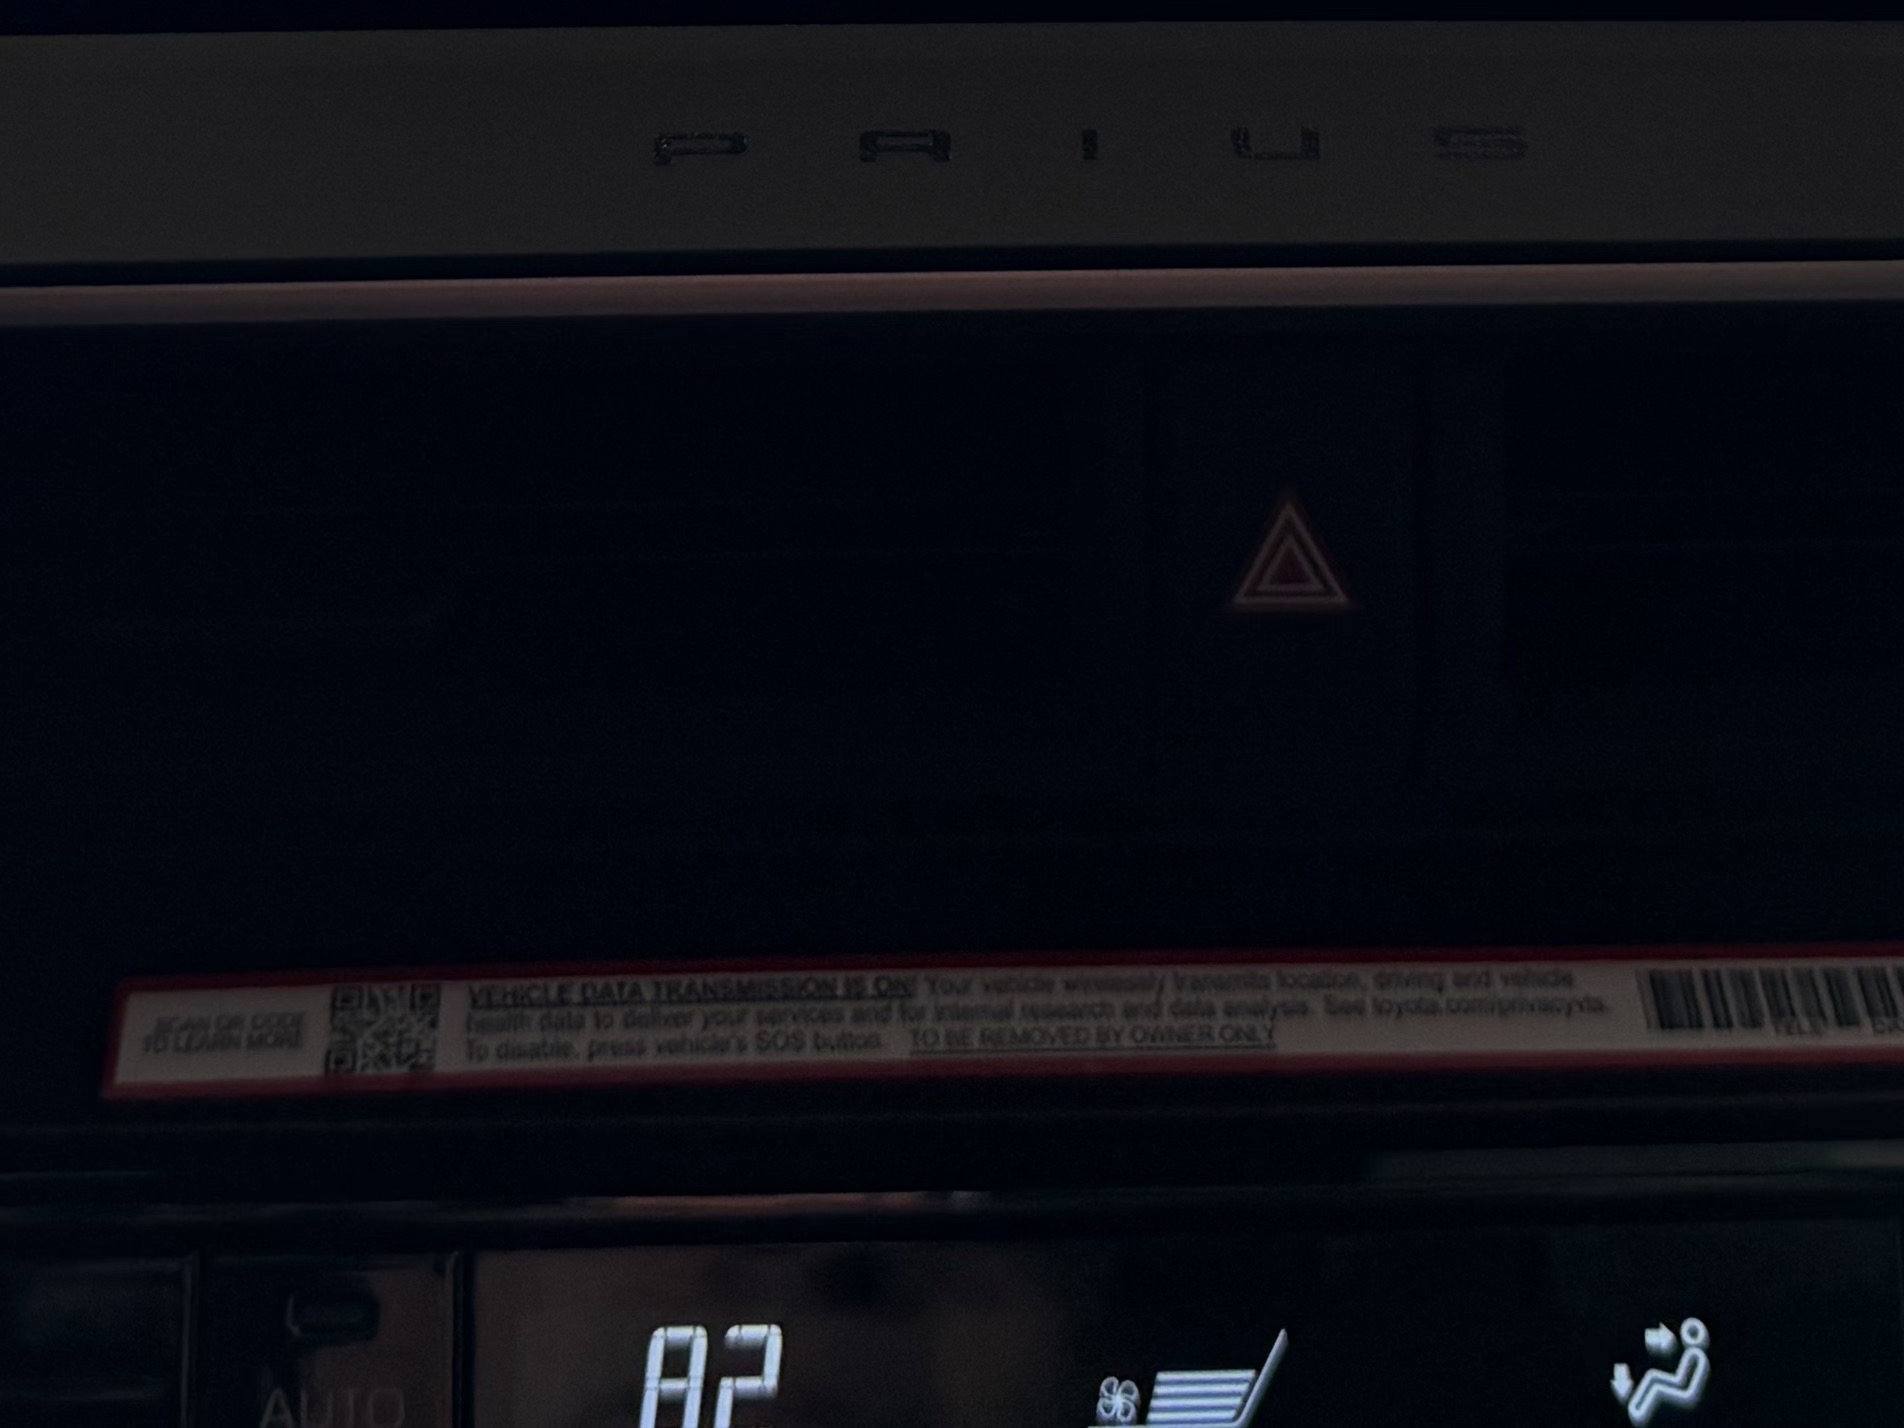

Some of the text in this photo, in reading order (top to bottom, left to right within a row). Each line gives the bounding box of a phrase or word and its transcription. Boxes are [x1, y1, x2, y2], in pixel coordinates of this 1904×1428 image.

[652, 124, 1530, 168] PRIUS
[638, 1323, 785, 1428] 82
[259, 1386, 407, 1428] AUTO
